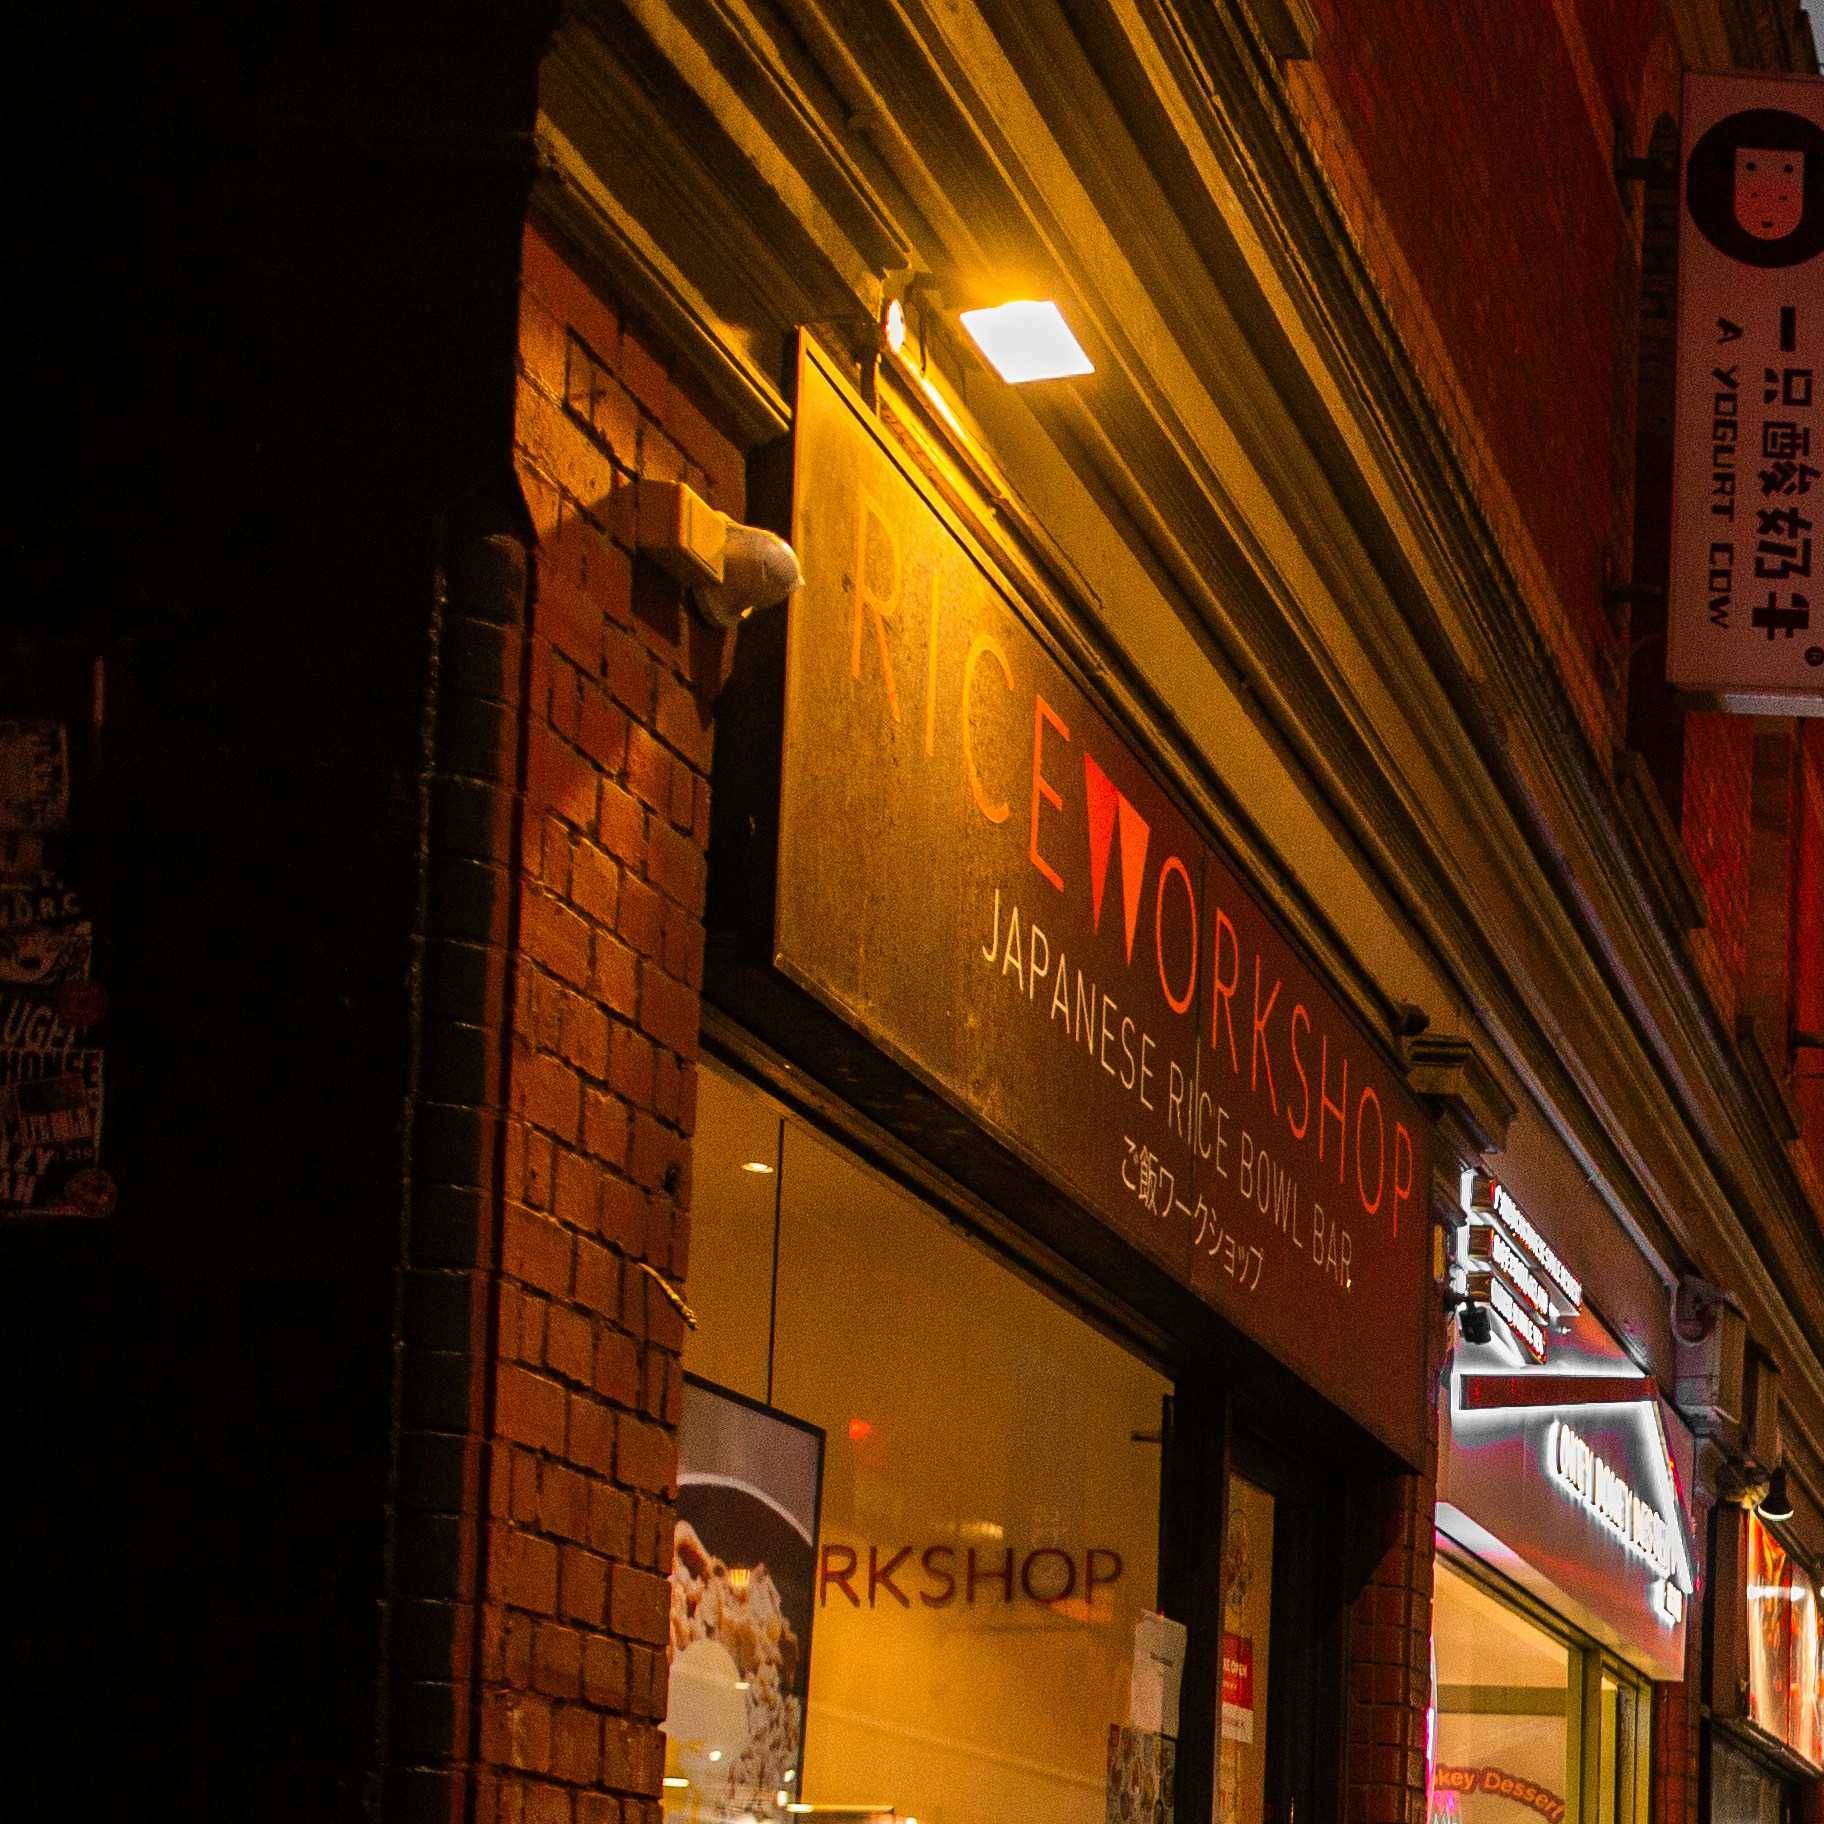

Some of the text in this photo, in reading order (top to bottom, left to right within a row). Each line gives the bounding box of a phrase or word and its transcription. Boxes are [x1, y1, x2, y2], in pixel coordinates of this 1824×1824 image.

[1710, 365, 1742, 523] YOGURT
[850, 487, 1070, 892] RICE
[1707, 543, 1734, 629] COW
[981, 888, 1158, 1110] JAPANESE
[1169, 1060, 1231, 1178] RICE
[1239, 1130, 1304, 1249] BOWL
[1313, 1203, 1353, 1288] BAR
